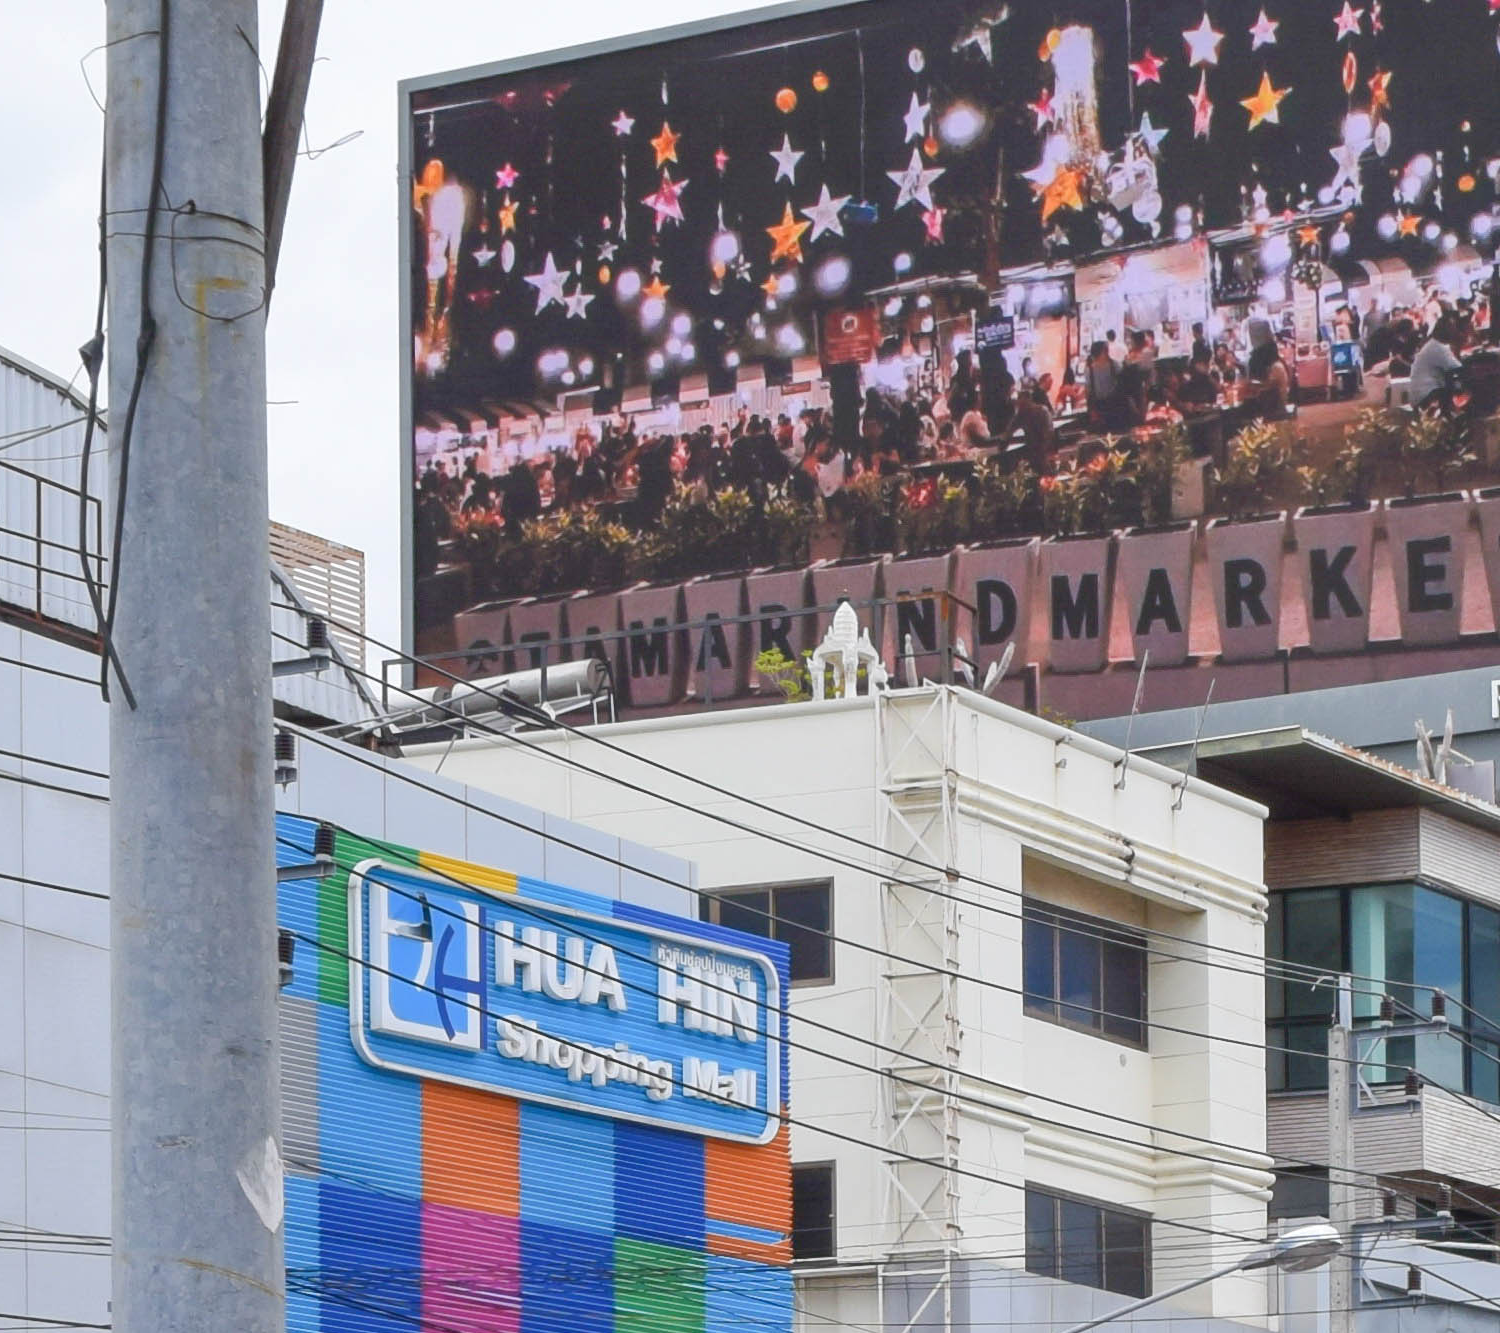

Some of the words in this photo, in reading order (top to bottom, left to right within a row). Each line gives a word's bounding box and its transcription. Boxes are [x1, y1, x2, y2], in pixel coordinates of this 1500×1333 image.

[494, 920, 628, 1012] HUA
[657, 958, 758, 1043] HIN
[496, 1014, 673, 1101] Shopping
[682, 1056, 757, 1108] Mall
